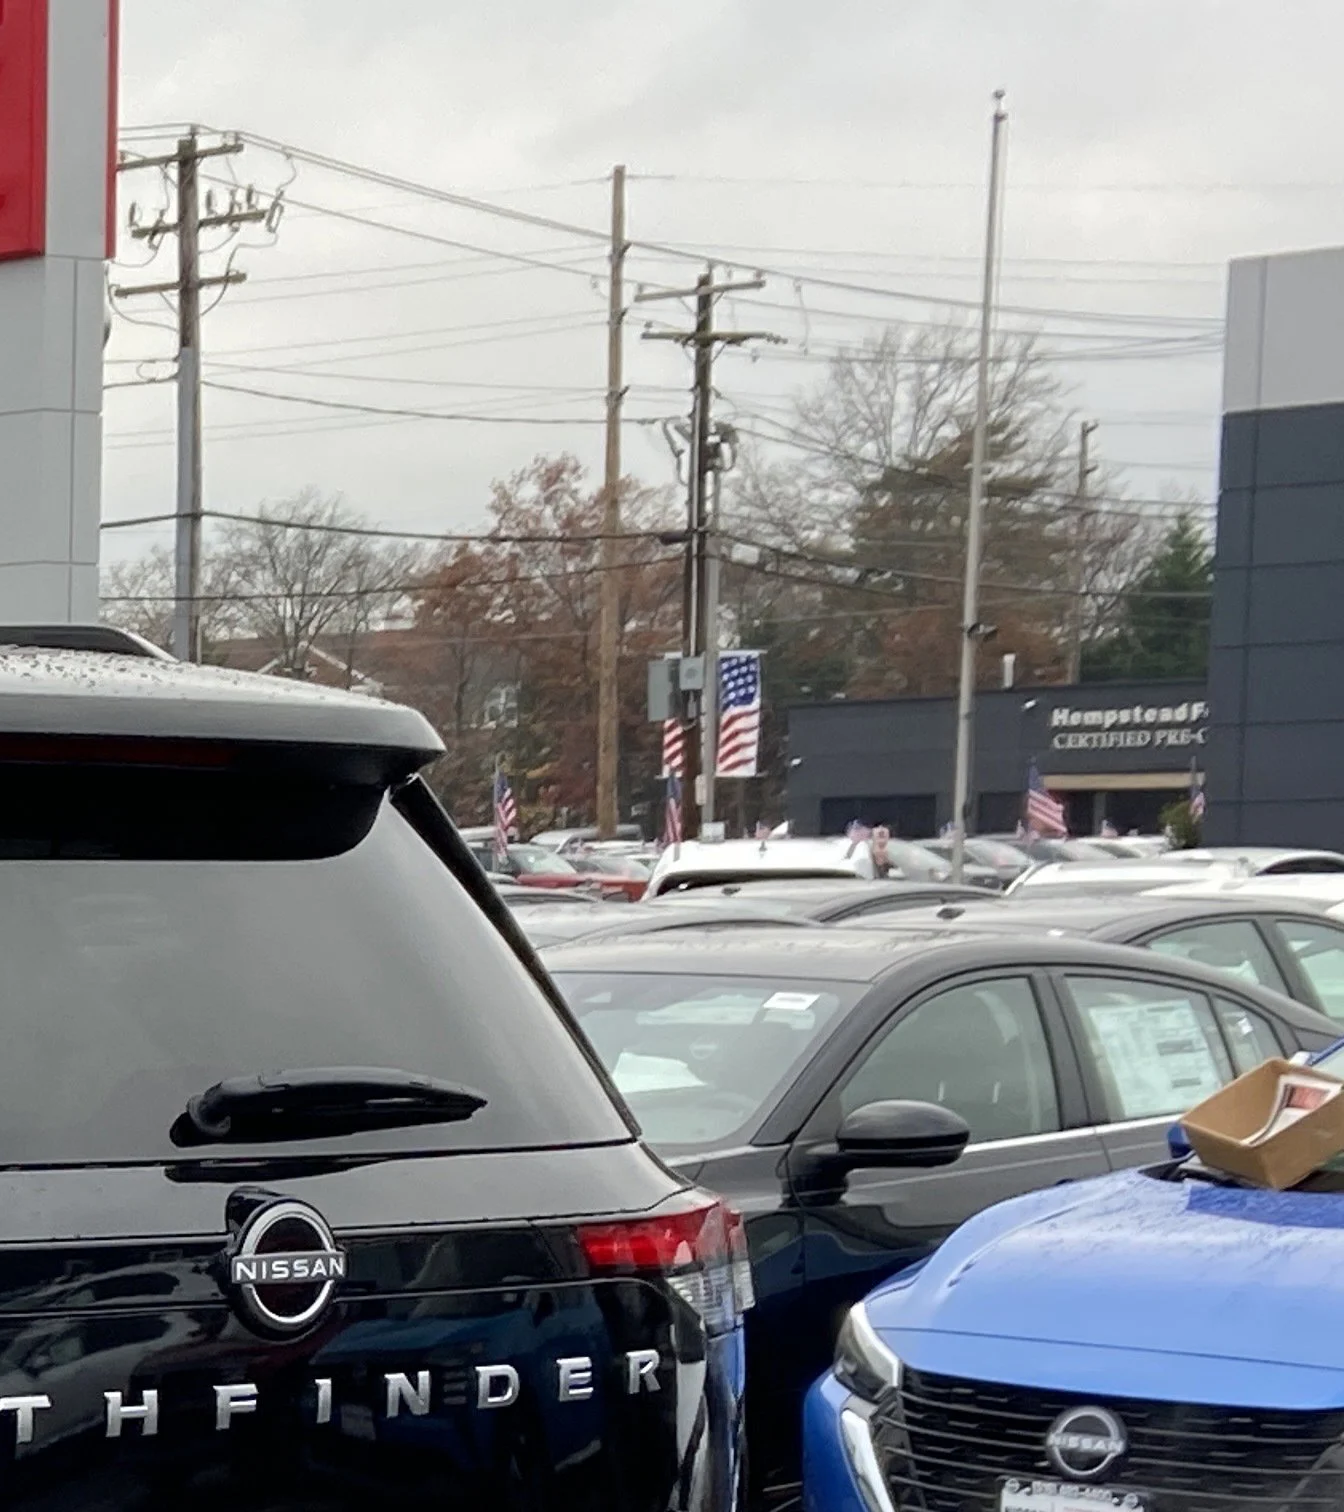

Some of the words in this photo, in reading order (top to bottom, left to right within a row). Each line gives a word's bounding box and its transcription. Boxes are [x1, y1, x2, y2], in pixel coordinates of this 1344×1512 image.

[1051, 702, 1188, 729] Hempstead
[1052, 731, 1151, 749] CERTIFIED
[236, 1257, 344, 1281] NISSAN
[1047, 1432, 1124, 1453] NISSAN
